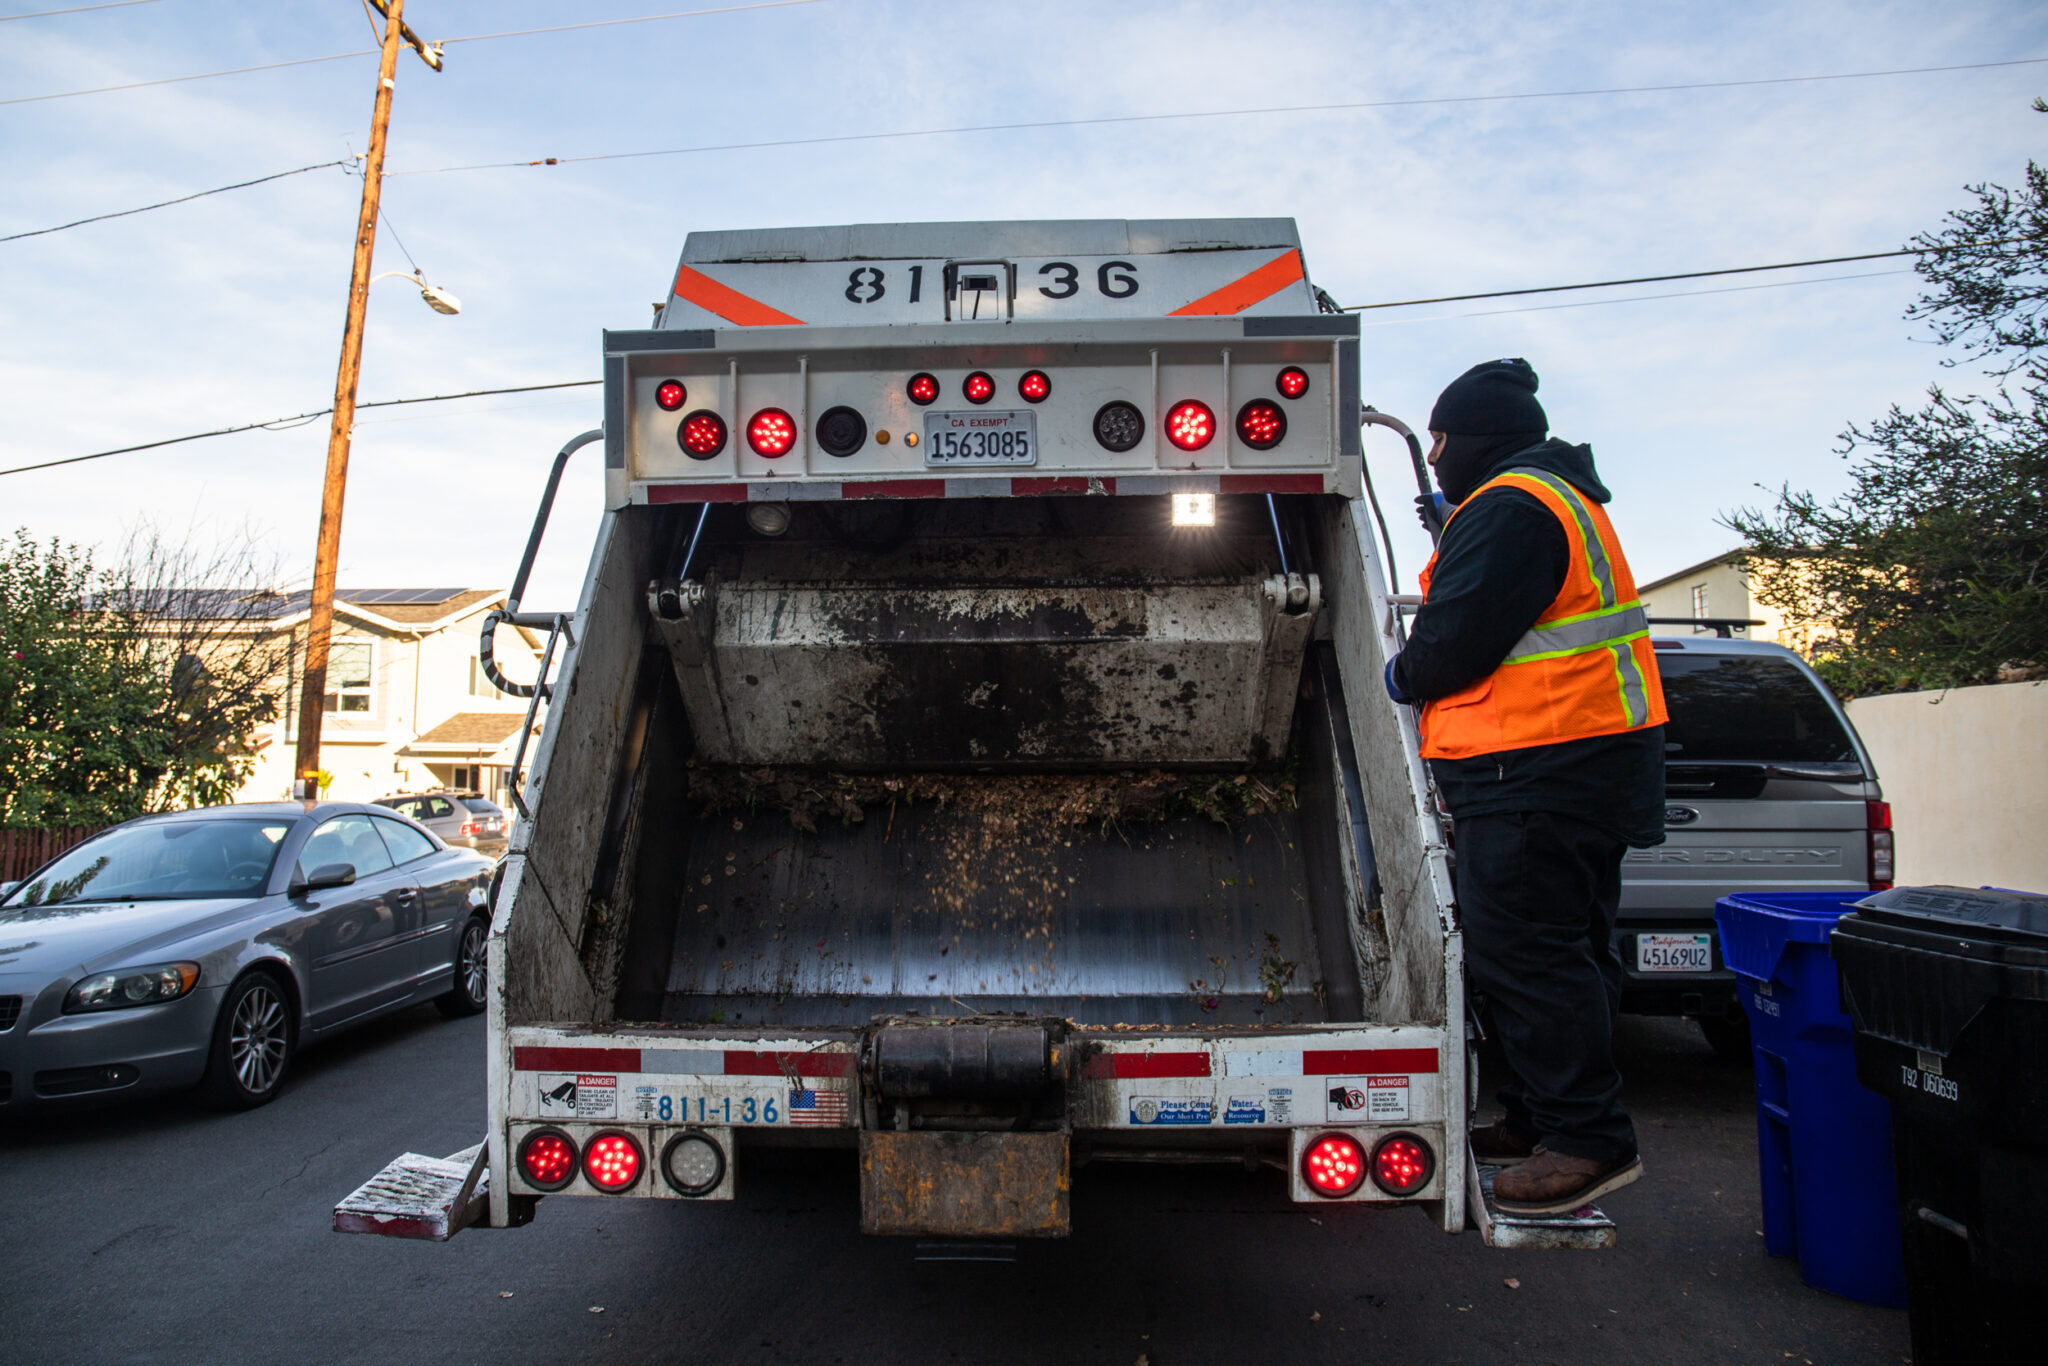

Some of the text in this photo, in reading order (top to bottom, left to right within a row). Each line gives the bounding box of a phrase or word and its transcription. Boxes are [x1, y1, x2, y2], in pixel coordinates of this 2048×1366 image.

[951, 418, 1008, 428] CA EXEMPT
[931, 430, 1029, 459] 1563085
[1664, 809, 1690, 820] Ford
[1704, 849, 1837, 863] DUTY
[1653, 935, 1697, 947] California
[1643, 948, 1707, 966] 45169U2
[1901, 1065, 1918, 1088] T92
[1923, 1072, 1958, 1101] 060699
[659, 1096, 778, 1123] 811-136
[1160, 1100, 1187, 1109] Please
[1160, 1112, 1175, 1120] Our
[1177, 1112, 1196, 1120] Most
